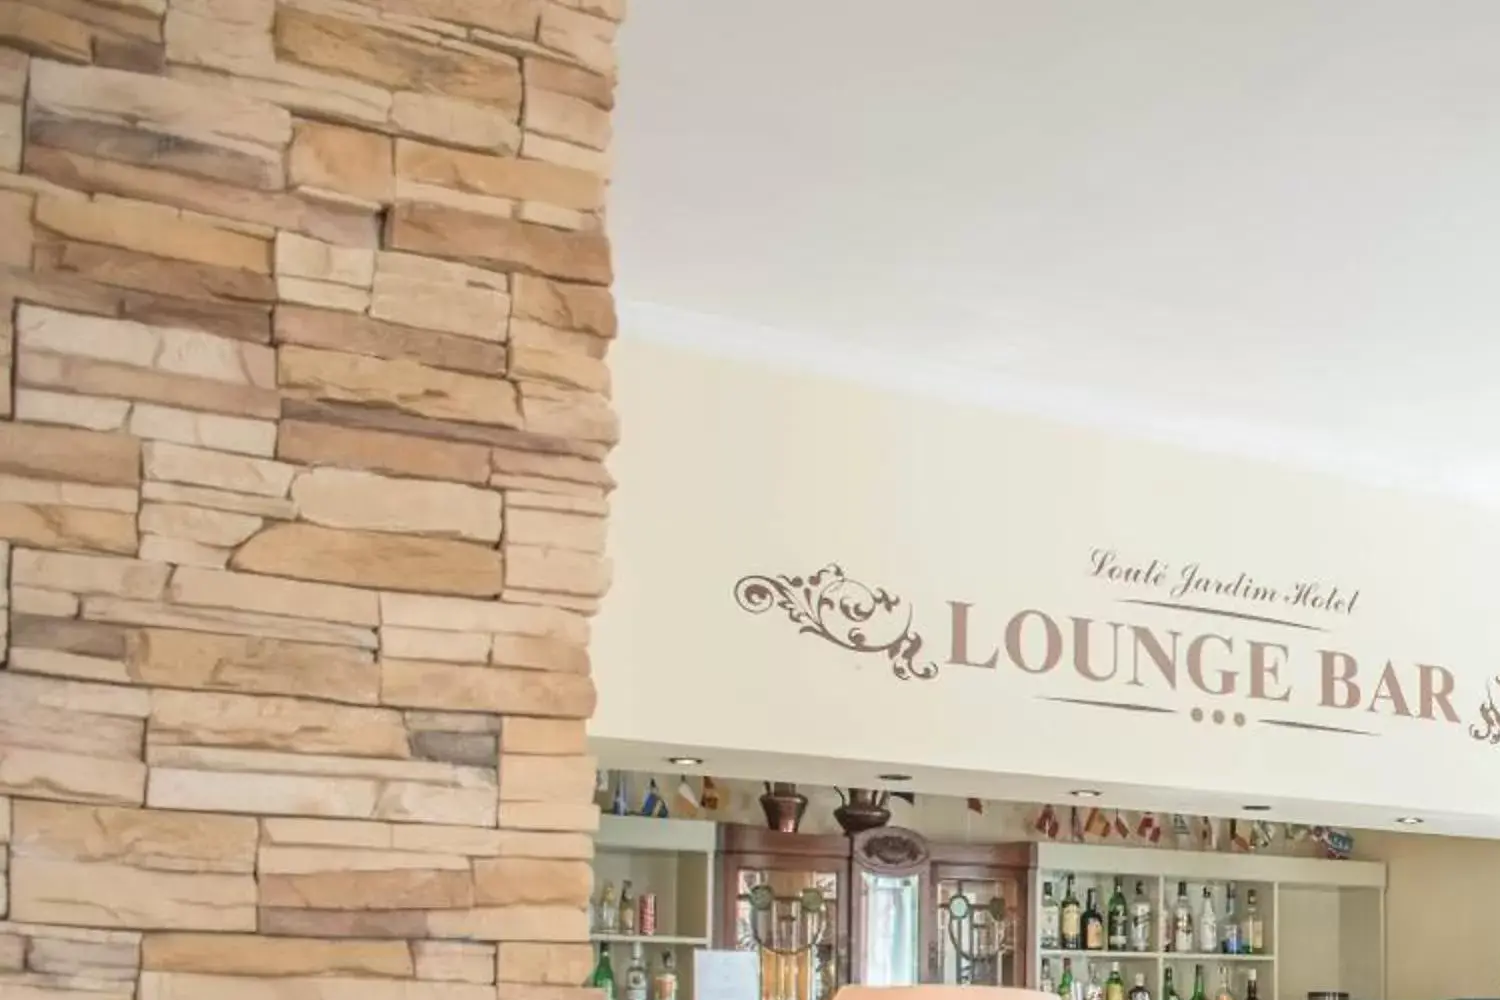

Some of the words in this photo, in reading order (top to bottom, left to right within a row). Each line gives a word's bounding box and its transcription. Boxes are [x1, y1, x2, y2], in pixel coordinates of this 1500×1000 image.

[1089, 548, 1168, 587] Loulé
[1169, 563, 1277, 603] Jardim
[1283, 582, 1360, 615] Hotel
[945, 600, 1293, 703] LOUNGE
[1315, 649, 1463, 724] BAR
